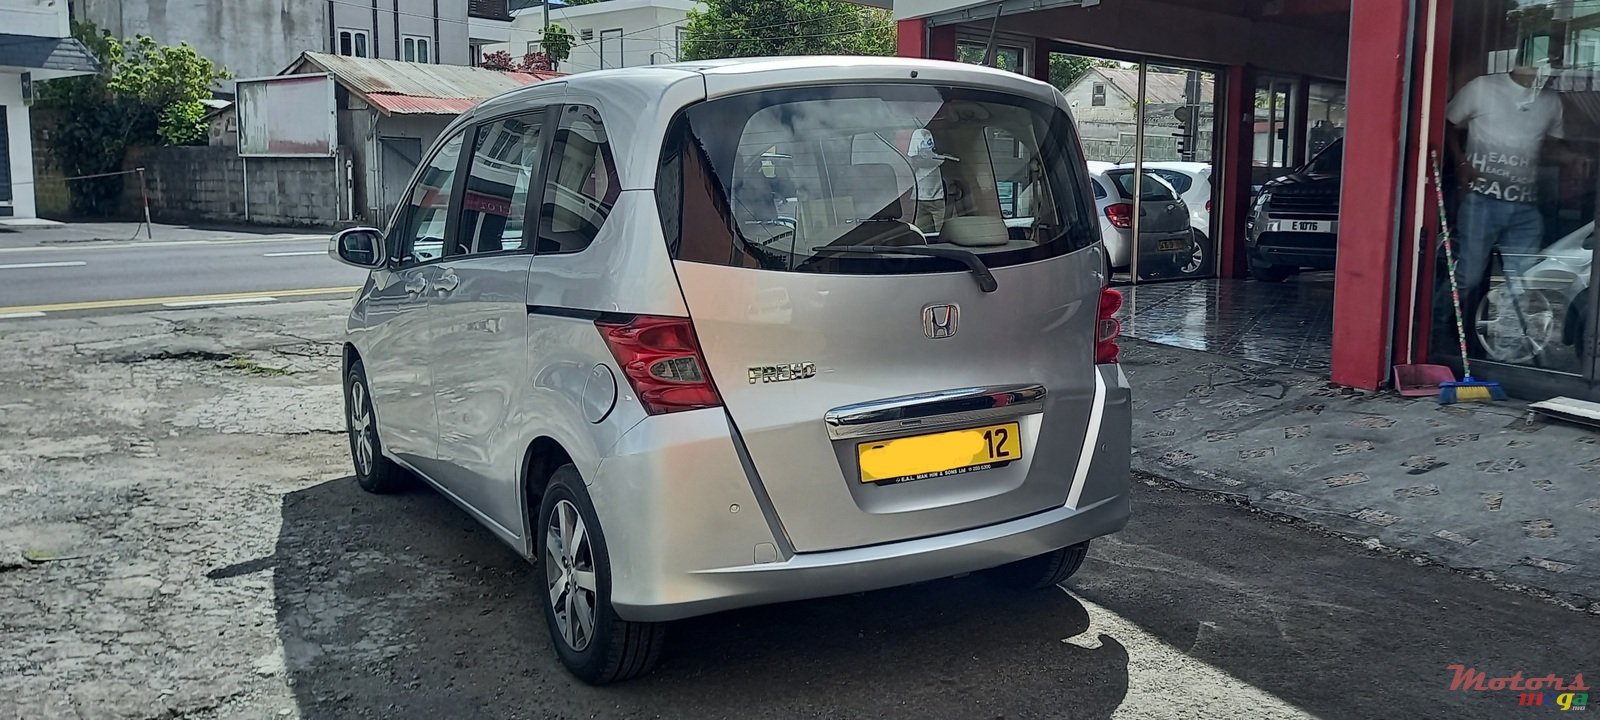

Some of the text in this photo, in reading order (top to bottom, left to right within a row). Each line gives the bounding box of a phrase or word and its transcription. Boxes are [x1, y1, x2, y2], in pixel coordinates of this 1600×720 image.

[1292, 221, 1298, 230] E
[748, 361, 816, 384] FREED
[983, 428, 1010, 459] 12
